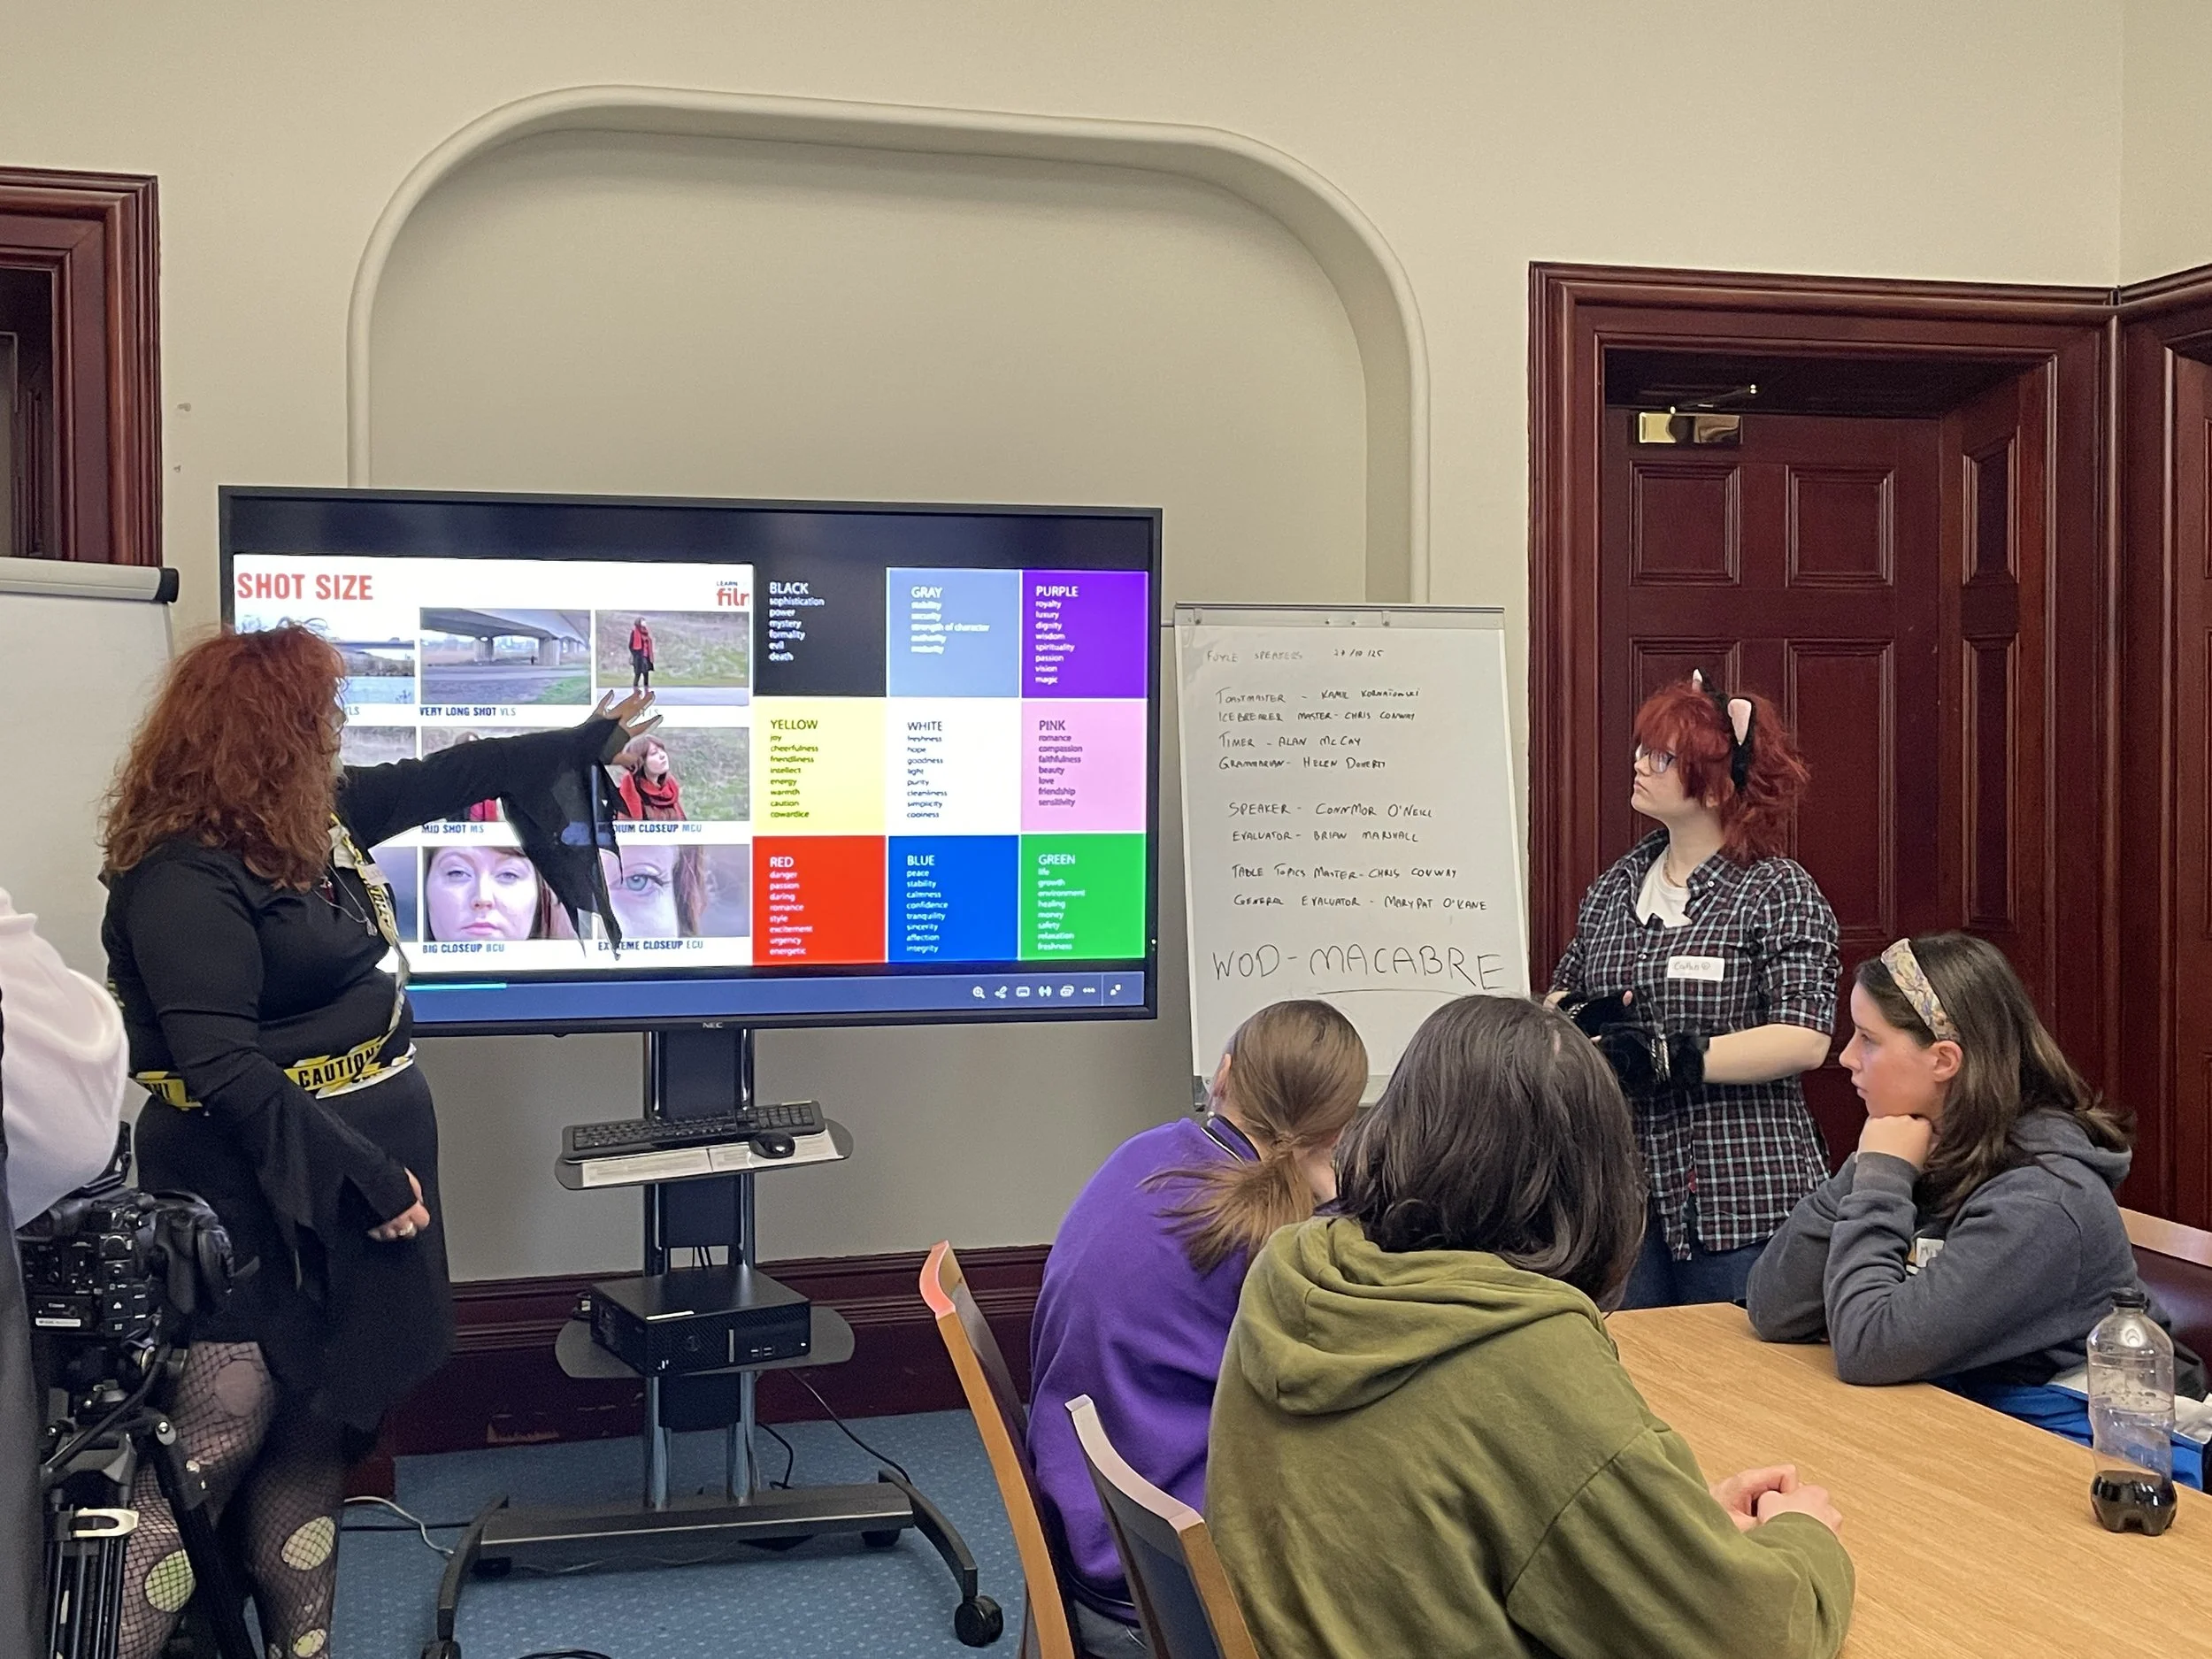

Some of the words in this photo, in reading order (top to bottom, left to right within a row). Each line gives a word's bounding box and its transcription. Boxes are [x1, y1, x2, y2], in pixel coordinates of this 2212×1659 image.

[237, 572, 305, 599] SHOT
[316, 574, 373, 600] SIZE
[769, 581, 809, 595] BLACK
[910, 586, 943, 598] GRAY
[1036, 585, 1079, 597] PURPLE
[769, 596, 825, 607] sophistication
[1035, 600, 1062, 609] royalty
[769, 609, 795, 618] power
[1035, 611, 1059, 620] luxury
[769, 619, 802, 629] mystery
[1035, 621, 1063, 631] dignity
[769, 628, 806, 641] formality
[768, 641, 785, 650] evil
[1035, 643, 1075, 652] spirituality
[768, 651, 794, 661] death
[1035, 676, 1058, 685] magic
[420, 707, 442, 716] VERY
[445, 707, 469, 716] LONG
[473, 707, 496, 716] SHOT
[500, 707, 516, 716] VLS
[1344, 711, 1371, 720] CHRIS
[770, 719, 818, 730] YELLOW
[907, 721, 942, 731] WHITE
[1039, 720, 1066, 731] PINK
[1279, 736, 1307, 747] ALAN
[770, 744, 819, 753] cheerfulness
[1038, 755, 1081, 764] faithfulness
[1303, 757, 1337, 768] HELEN
[1038, 766, 1065, 776] beauty
[1038, 776, 1055, 785] love
[1038, 787, 1076, 796] friendship
[1038, 798, 1076, 808] sensitivity
[1229, 802, 1291, 818] SPEAKER
[442, 825, 466, 833] SHOT
[470, 825, 484, 833] MS
[639, 824, 679, 833] CLOSEUP
[682, 824, 702, 833] MCU
[1313, 830, 1348, 840] BRIAN
[770, 856, 794, 868] RED
[907, 855, 935, 866] BLUE
[1038, 854, 1076, 865] GREEN
[1232, 863, 1263, 878] TABLE
[770, 871, 798, 880] danger
[770, 883, 800, 891] passion
[906, 880, 937, 889] stability
[770, 893, 796, 902] daring
[906, 901, 949, 910] confidence
[1038, 900, 1066, 910] healing
[770, 915, 789, 924] style
[643, 941, 683, 950] CLOSEUP
[687, 941, 703, 949] ECU
[770, 937, 802, 946] urgency
[423, 945, 438, 953] BIG
[442, 944, 483, 953] CLOSEUP
[486, 944, 505, 952] BCU
[770, 948, 806, 957] energetic
[906, 945, 939, 954] integrity
[297, 1048, 375, 1088] CAUTION
